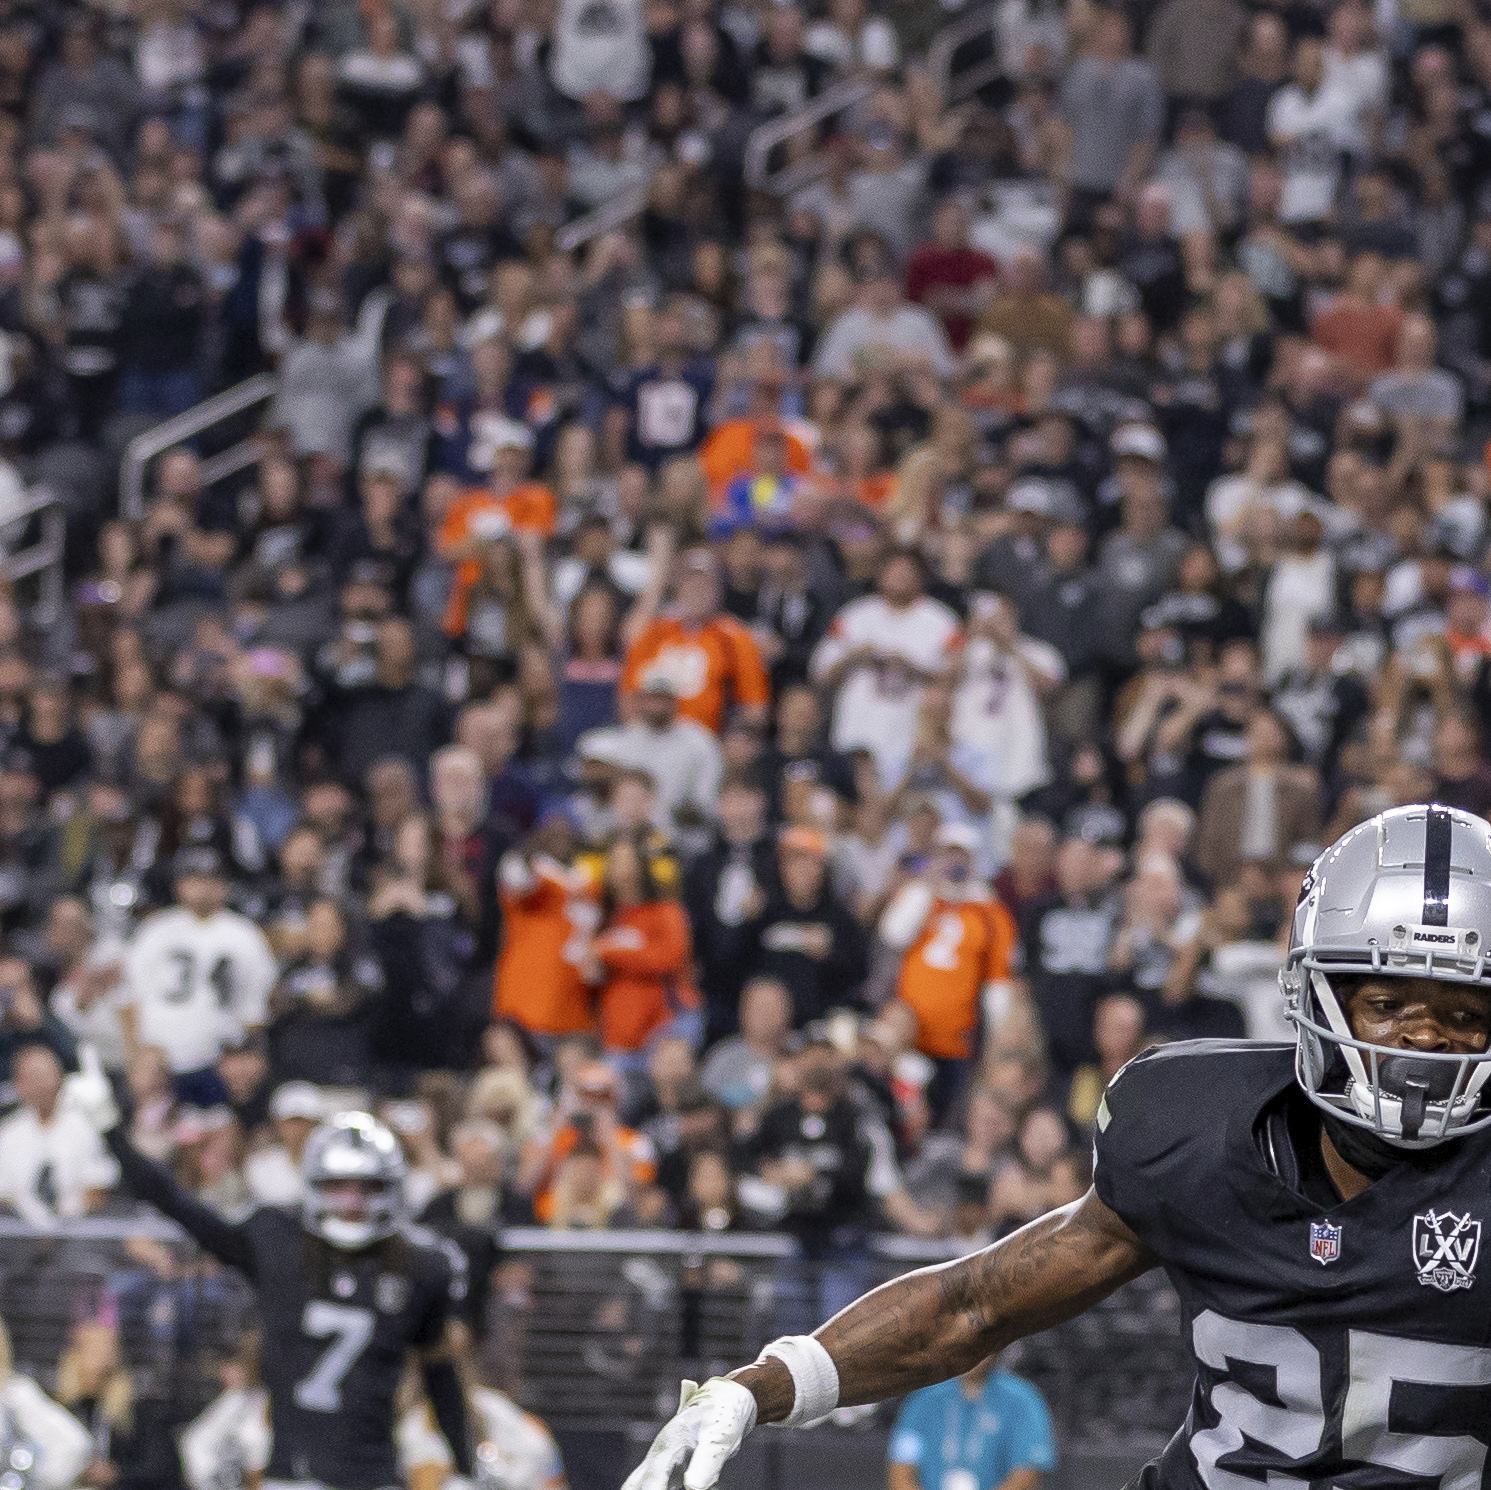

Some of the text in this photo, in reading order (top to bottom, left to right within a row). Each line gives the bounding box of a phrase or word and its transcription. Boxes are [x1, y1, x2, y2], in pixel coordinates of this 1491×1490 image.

[1414, 932, 1455, 943] RAIDERS
[1419, 1233, 1474, 1262] LXV
[294, 1301, 376, 1412] 7
